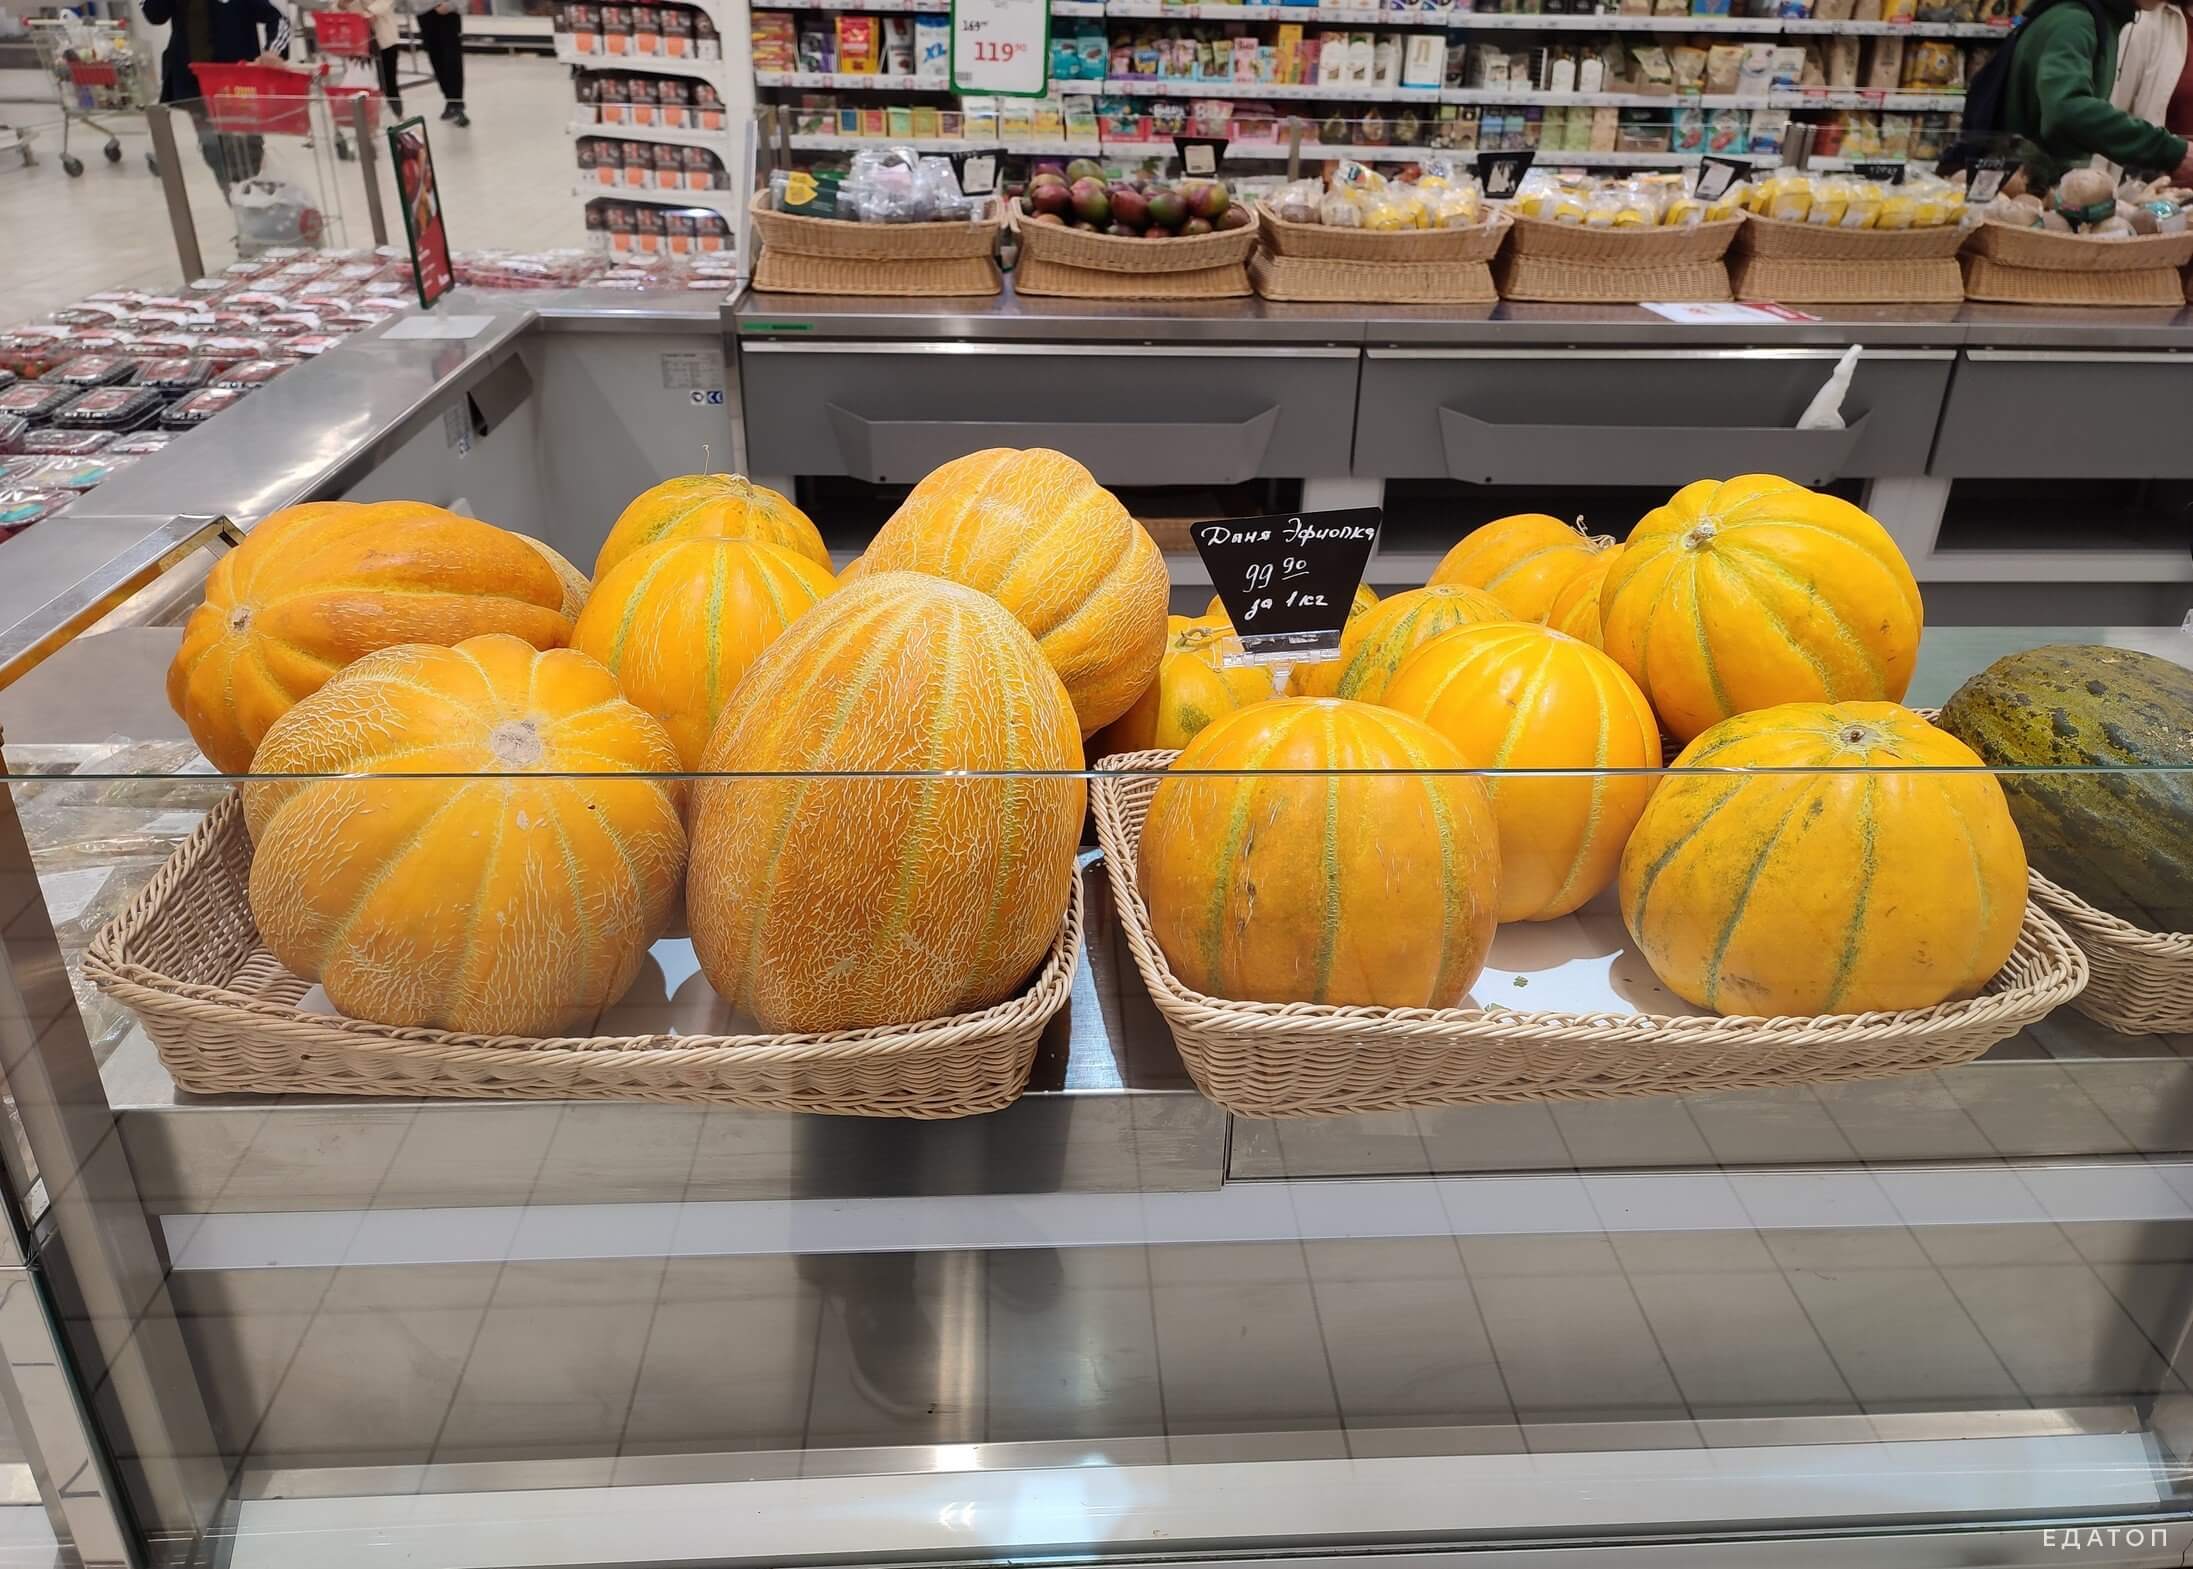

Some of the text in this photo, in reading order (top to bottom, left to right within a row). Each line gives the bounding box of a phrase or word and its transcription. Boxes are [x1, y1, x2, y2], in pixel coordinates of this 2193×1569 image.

[1282, 517, 1375, 547] Эфиопка
[1242, 563, 1274, 593] 99
[1244, 598, 1273, 621] за
